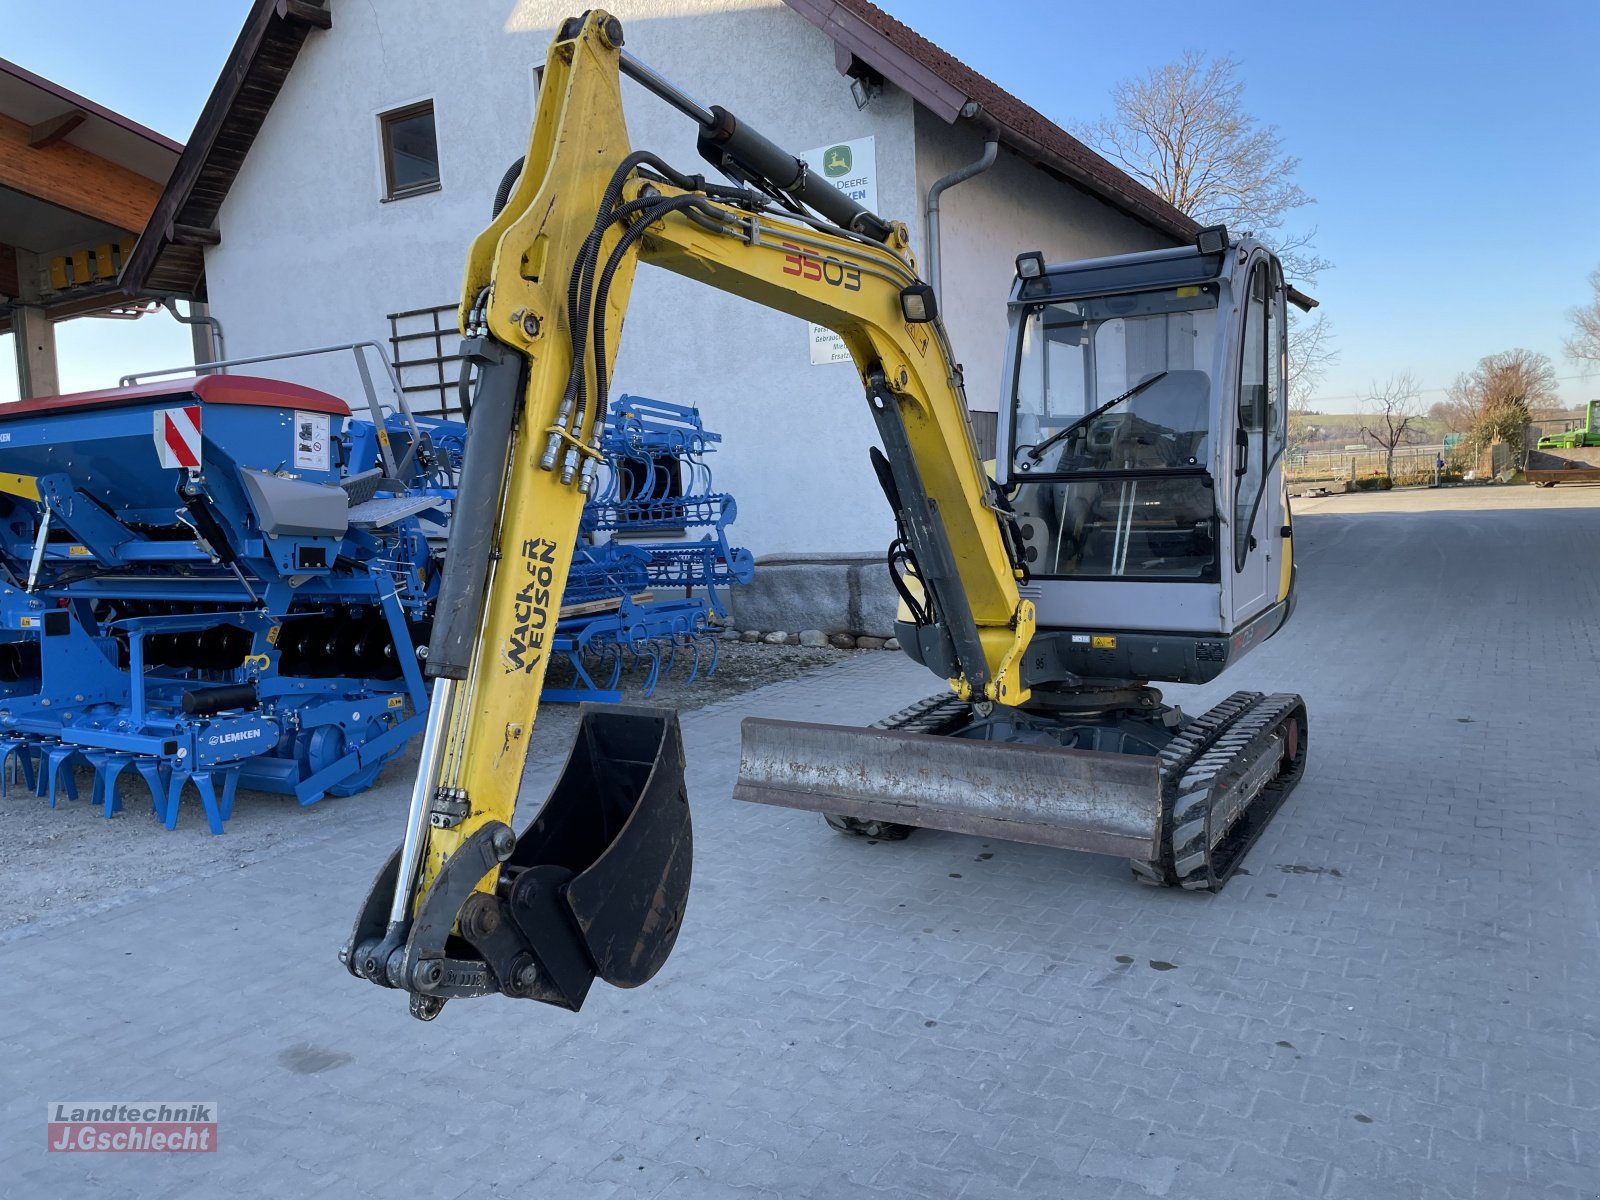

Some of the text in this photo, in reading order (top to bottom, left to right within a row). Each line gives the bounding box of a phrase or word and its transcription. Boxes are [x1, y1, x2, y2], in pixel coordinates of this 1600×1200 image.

[837, 177, 868, 189] DEERE
[782, 242, 861, 292] 3503
[219, 729, 261, 744] LEMKEN
